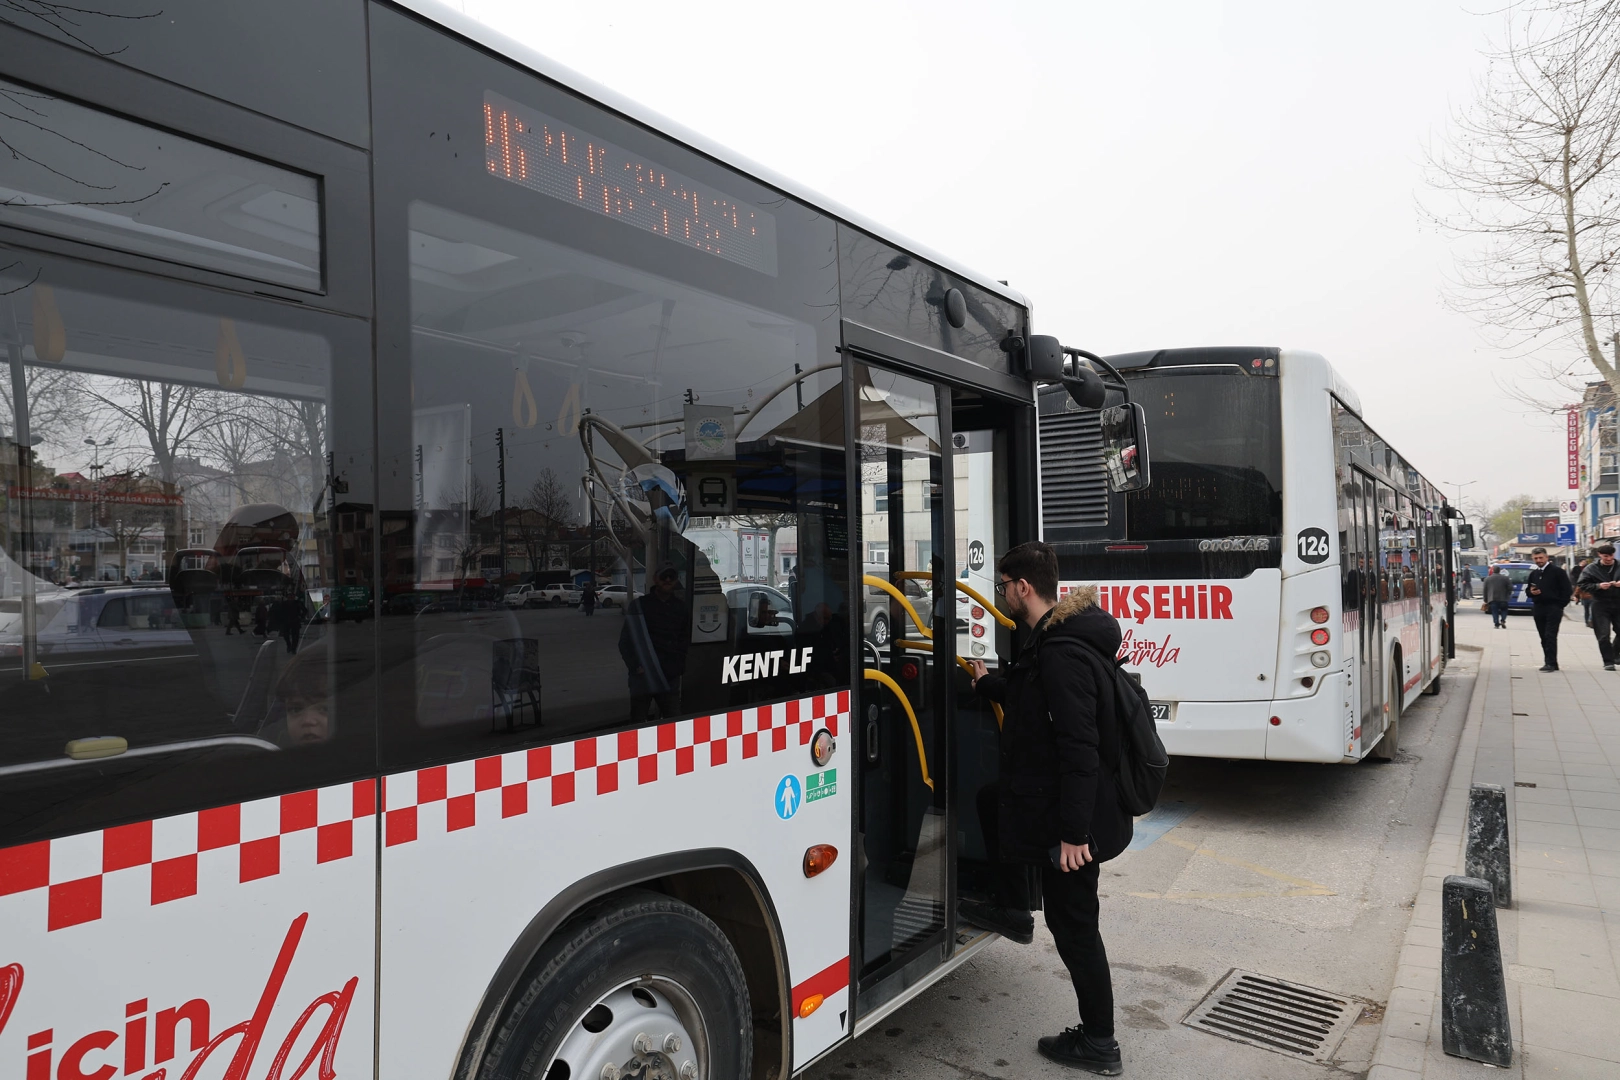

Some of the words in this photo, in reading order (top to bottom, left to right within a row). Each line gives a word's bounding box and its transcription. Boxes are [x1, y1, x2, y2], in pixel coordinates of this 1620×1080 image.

[1569, 454, 1577, 485] KURSU
[1557, 525, 1569, 538] P
[1199, 538, 1269, 552] OTOKAR
[1298, 536, 1328, 556] 126
[969, 547, 983, 564] 126
[1133, 639, 1156, 651] için
[722, 649, 785, 684] KENT
[789, 646, 813, 674] LF
